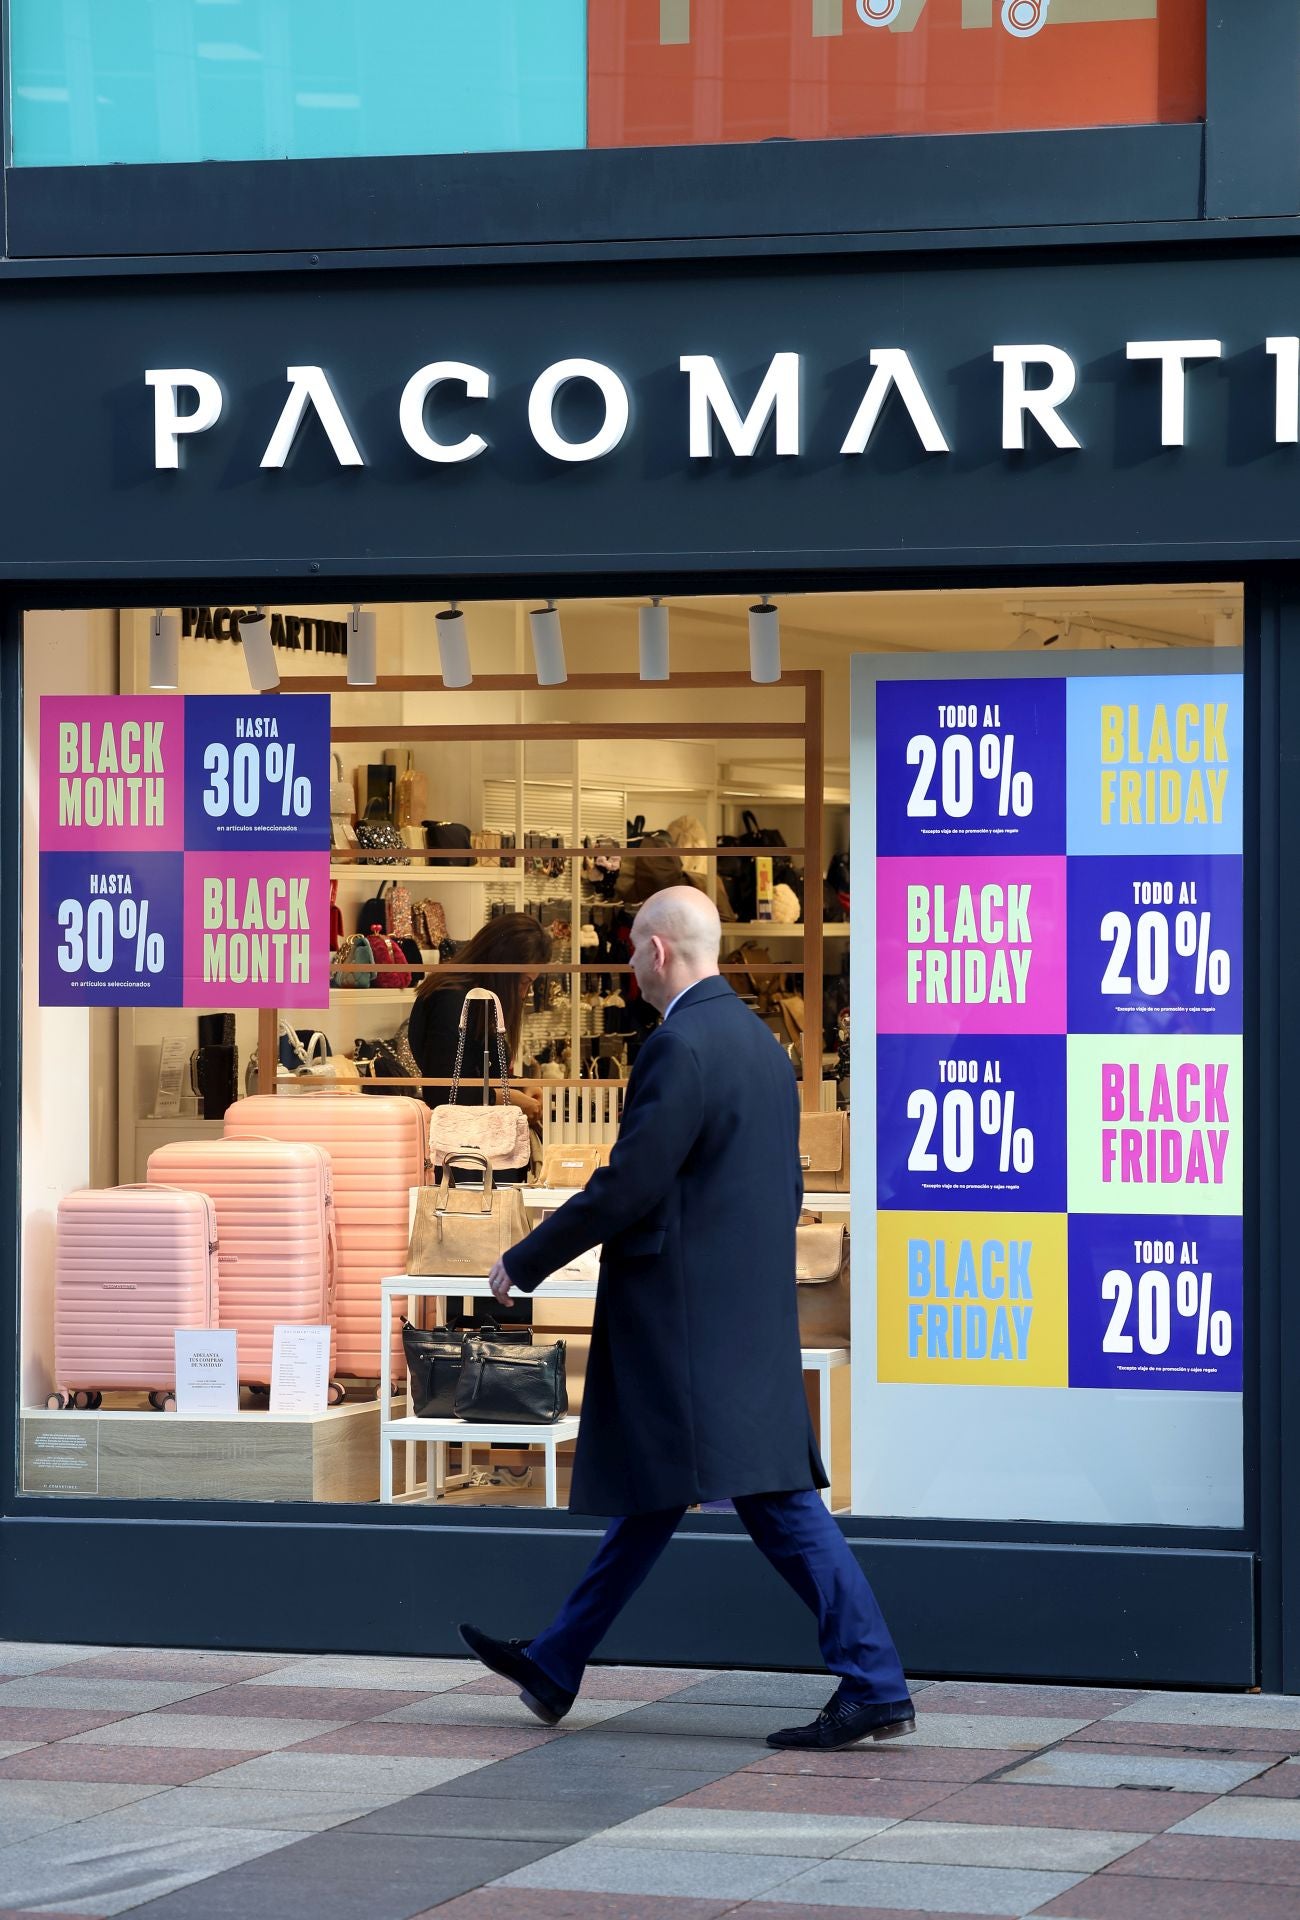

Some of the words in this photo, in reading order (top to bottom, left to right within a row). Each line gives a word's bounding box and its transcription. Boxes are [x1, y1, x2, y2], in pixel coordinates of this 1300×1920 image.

[144, 336, 1300, 471] PACOMARTI
[237, 718, 278, 737] HASTA
[938, 705, 977, 728] TODO
[983, 705, 1000, 727] AL
[1102, 704, 1228, 763] BLACK
[60, 721, 164, 773] BLACK
[60, 777, 164, 826] MONTH
[204, 743, 311, 817] 30%
[907, 734, 1033, 817] 20%
[1102, 769, 1228, 824] FRIDAY
[254, 824, 297, 832] seleccionados
[91, 875, 132, 894] HASTA
[204, 877, 310, 930] BLACK
[1133, 882, 1173, 904] TODO
[1179, 882, 1197, 904] AL
[58, 899, 164, 973] 30%
[907, 884, 1032, 944] BLACK
[203, 933, 309, 984] MONTH
[907, 949, 1032, 1004] FRIDAY
[1101, 911, 1230, 995] 20%
[108, 980, 150, 988] seleccionados
[939, 1060, 977, 1083] TODO
[984, 1061, 1001, 1082] AL
[1102, 1063, 1229, 1123] BLACK
[907, 1089, 1033, 1173] 20%
[1102, 1129, 1229, 1184] FRIDAY
[908, 1239, 1032, 1300] BLACK
[1134, 1241, 1174, 1264] TODO
[1180, 1242, 1198, 1264] AL
[908, 1303, 1033, 1360] FRIDAY
[1102, 1270, 1231, 1356] 20%
